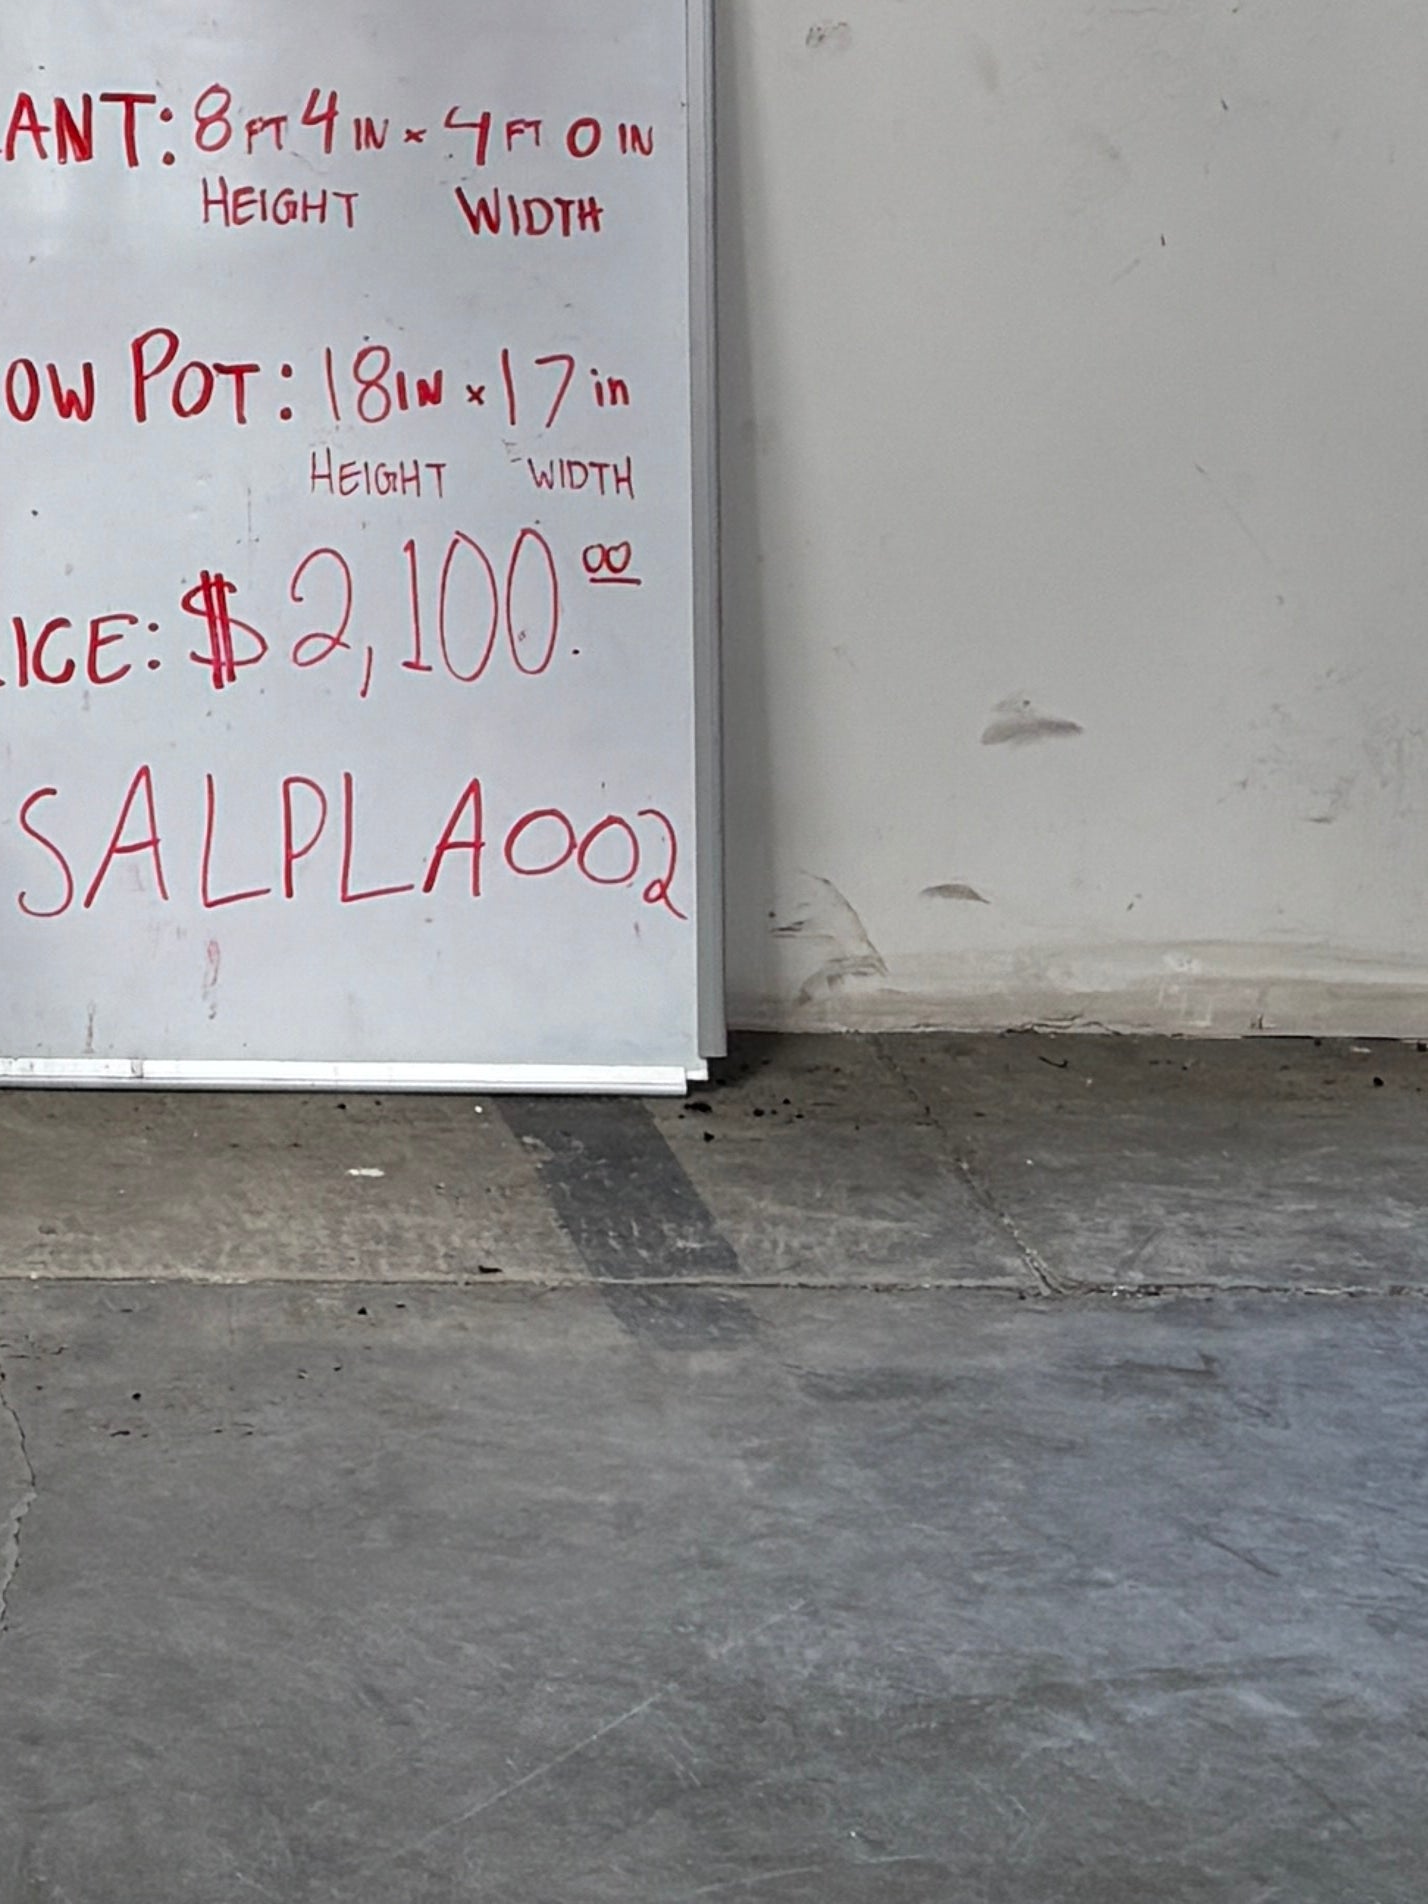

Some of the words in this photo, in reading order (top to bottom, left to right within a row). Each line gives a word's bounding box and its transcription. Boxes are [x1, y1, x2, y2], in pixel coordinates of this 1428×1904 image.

[202, 176, 360, 229] HEIGHT
[455, 186, 605, 237] WIDTH
[130, 327, 294, 425] POT:
[310, 446, 446, 498] HEIGHT
[527, 455, 635, 500] WIDTH
[17, 764, 689, 920] SALPLA002
